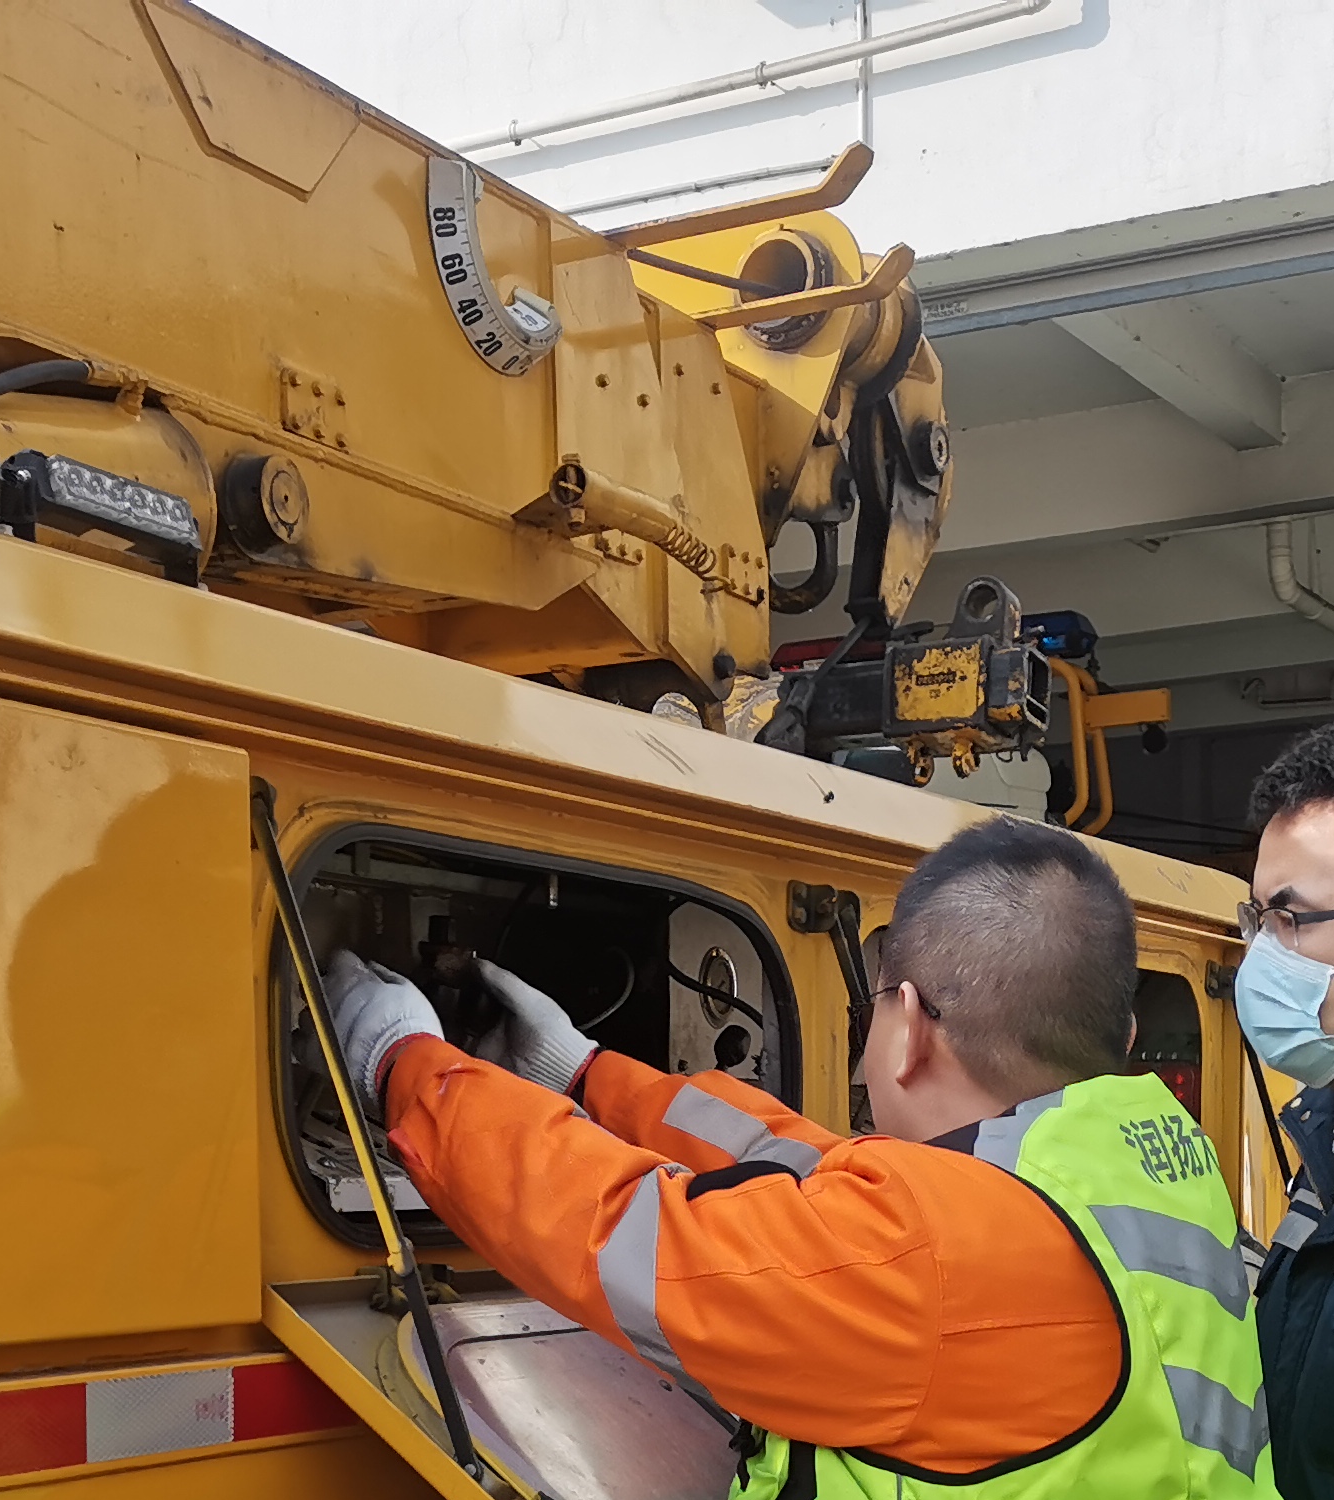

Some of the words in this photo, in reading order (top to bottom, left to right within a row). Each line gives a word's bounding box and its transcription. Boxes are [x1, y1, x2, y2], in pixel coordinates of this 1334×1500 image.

[433, 206, 458, 238] 80
[441, 252, 468, 286] 60
[457, 298, 484, 327] 40
[474, 331, 503, 357] 20
